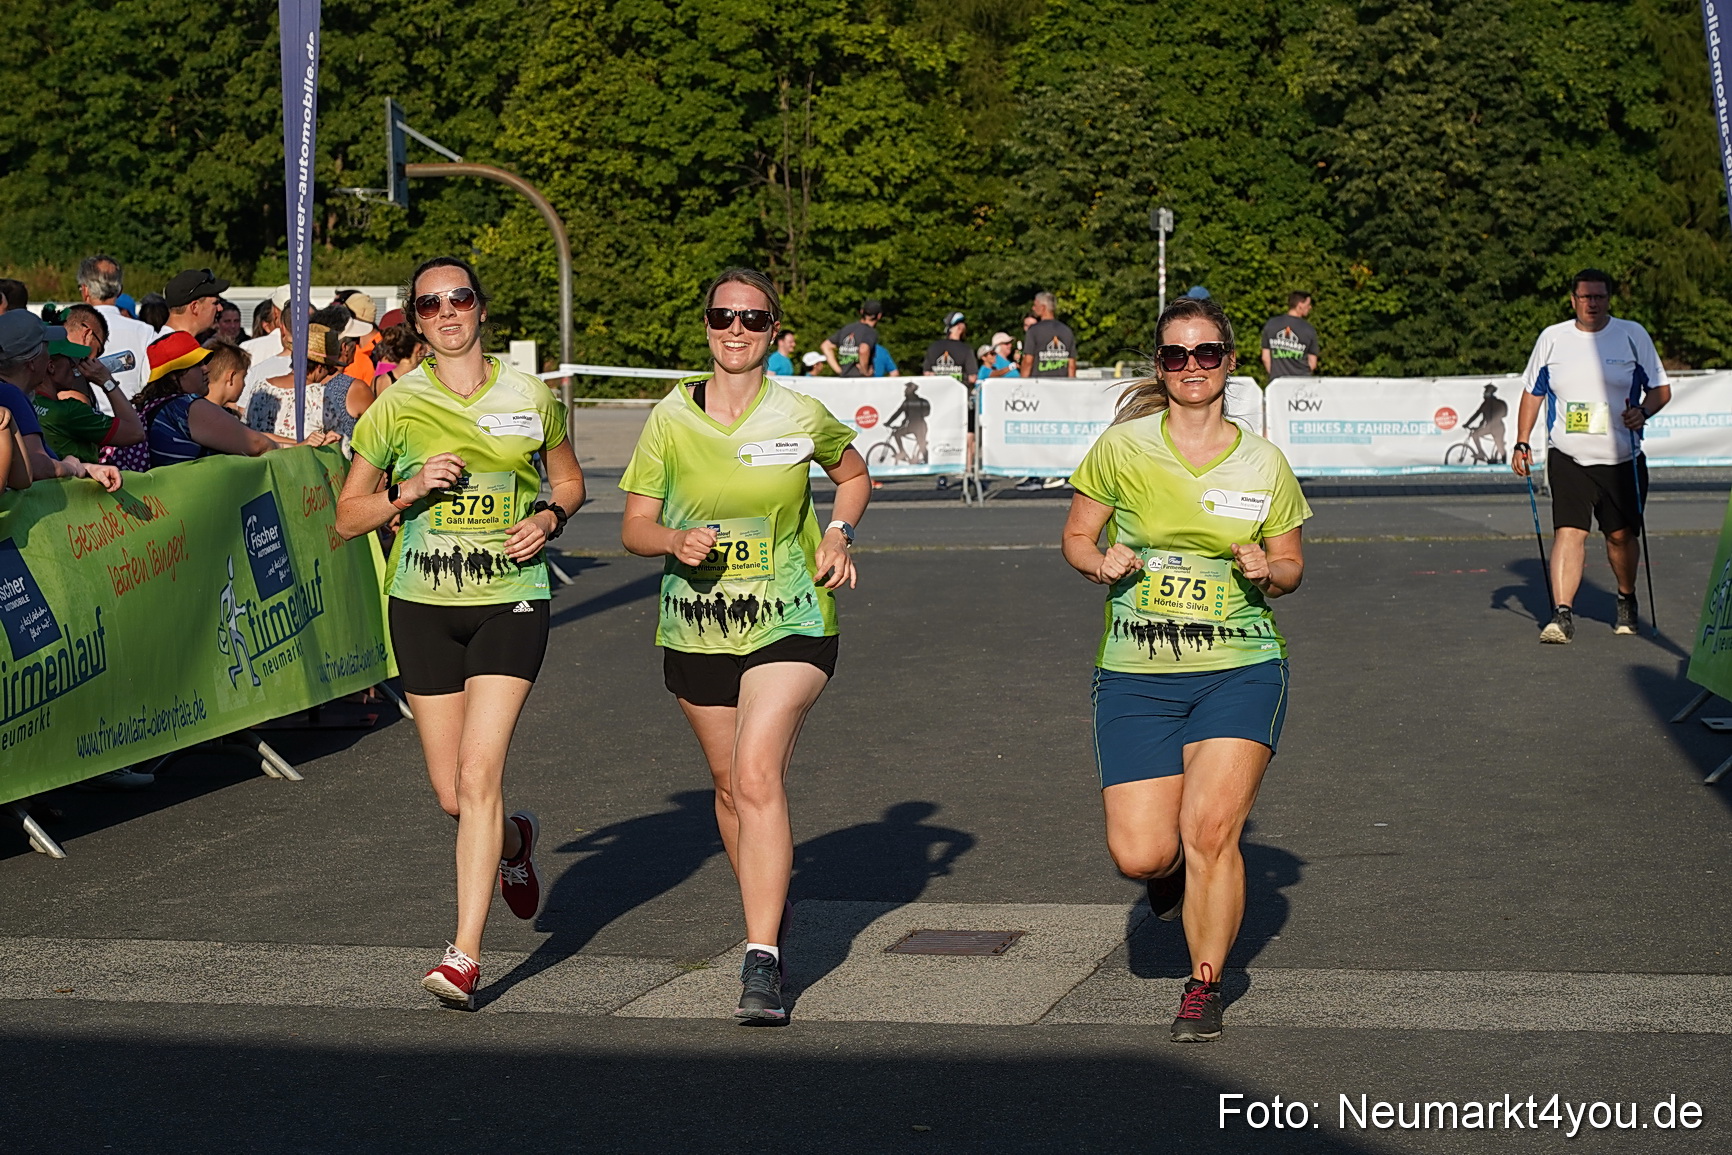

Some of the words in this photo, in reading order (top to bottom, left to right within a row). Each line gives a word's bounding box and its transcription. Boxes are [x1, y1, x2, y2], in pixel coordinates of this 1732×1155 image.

[1004, 400, 1040, 412] NOW
[1288, 400, 1323, 412] NOW
[1006, 422, 1057, 434] E-BIKES
[1061, 422, 1071, 434] &
[1290, 422, 1341, 434] E-BIKES
[1343, 423, 1353, 434] &
[451, 494, 495, 516] 579
[503, 496, 511, 524] 2022
[446, 516, 465, 525] Gäßl
[467, 516, 500, 525] Marcella
[250, 524, 280, 551] Fischer
[731, 562, 761, 570] Stefanie
[759, 541, 769, 571] 2022
[1141, 575, 1151, 606] WALK
[1159, 574, 1207, 601] 575
[1214, 585, 1225, 616] 2022
[1153, 597, 1184, 609] Hörteis
[1185, 601, 1209, 611] Silvia
[0, 606, 106, 726] irmenlauf
[1, 706, 52, 751] eumarkt
[76, 689, 207, 758] www.firmenlauf-oberpfalz.de
